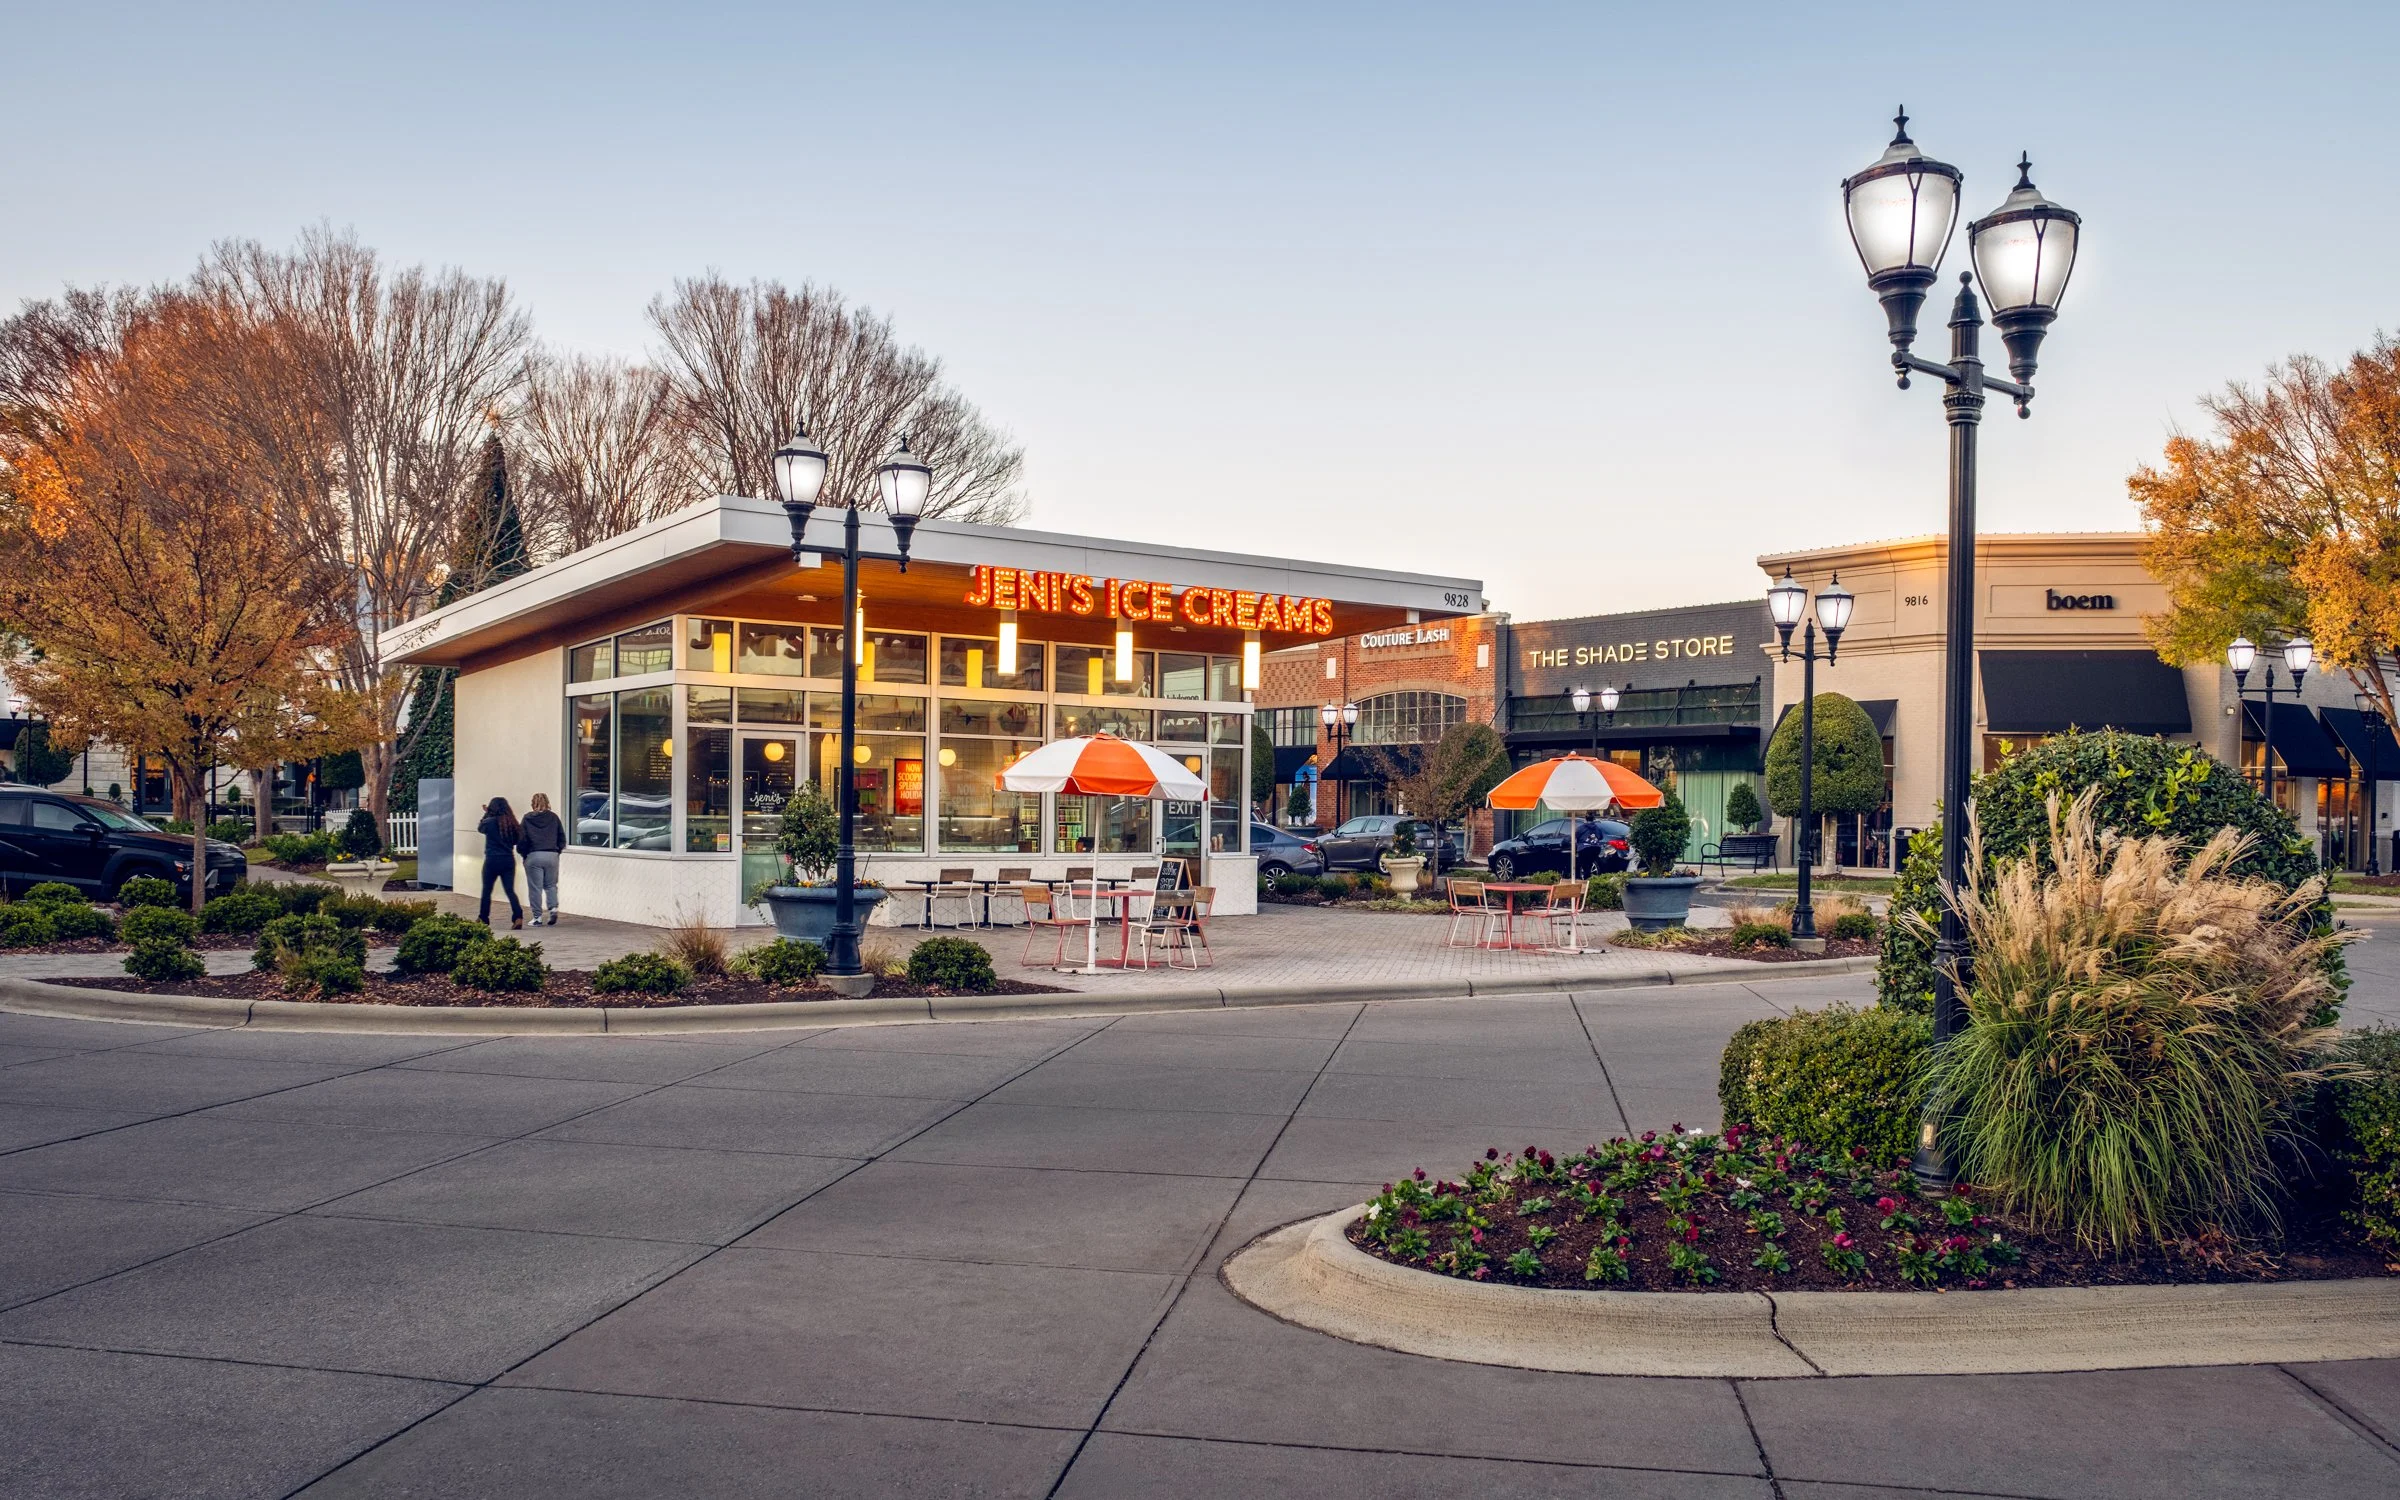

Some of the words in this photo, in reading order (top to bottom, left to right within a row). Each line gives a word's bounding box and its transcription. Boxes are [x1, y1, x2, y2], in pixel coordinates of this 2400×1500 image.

[963, 565, 1094, 615] JENI'S
[1104, 578, 1173, 621] ICE
[1181, 586, 1333, 635] CREAMS
[1444, 592, 1469, 608] 9828
[1904, 595, 1929, 607] 9816
[2045, 588, 2115, 611] boem
[1360, 632, 1414, 648] COUTURE
[1415, 628, 1450, 644] LASH
[1529, 648, 1569, 668] THE
[1575, 642, 1648, 666] SHADE
[1655, 635, 1734, 660] STORE
[905, 763, 922, 772] NOW
[750, 791, 786, 807] jeni's
[1169, 801, 1196, 815] EXIT
